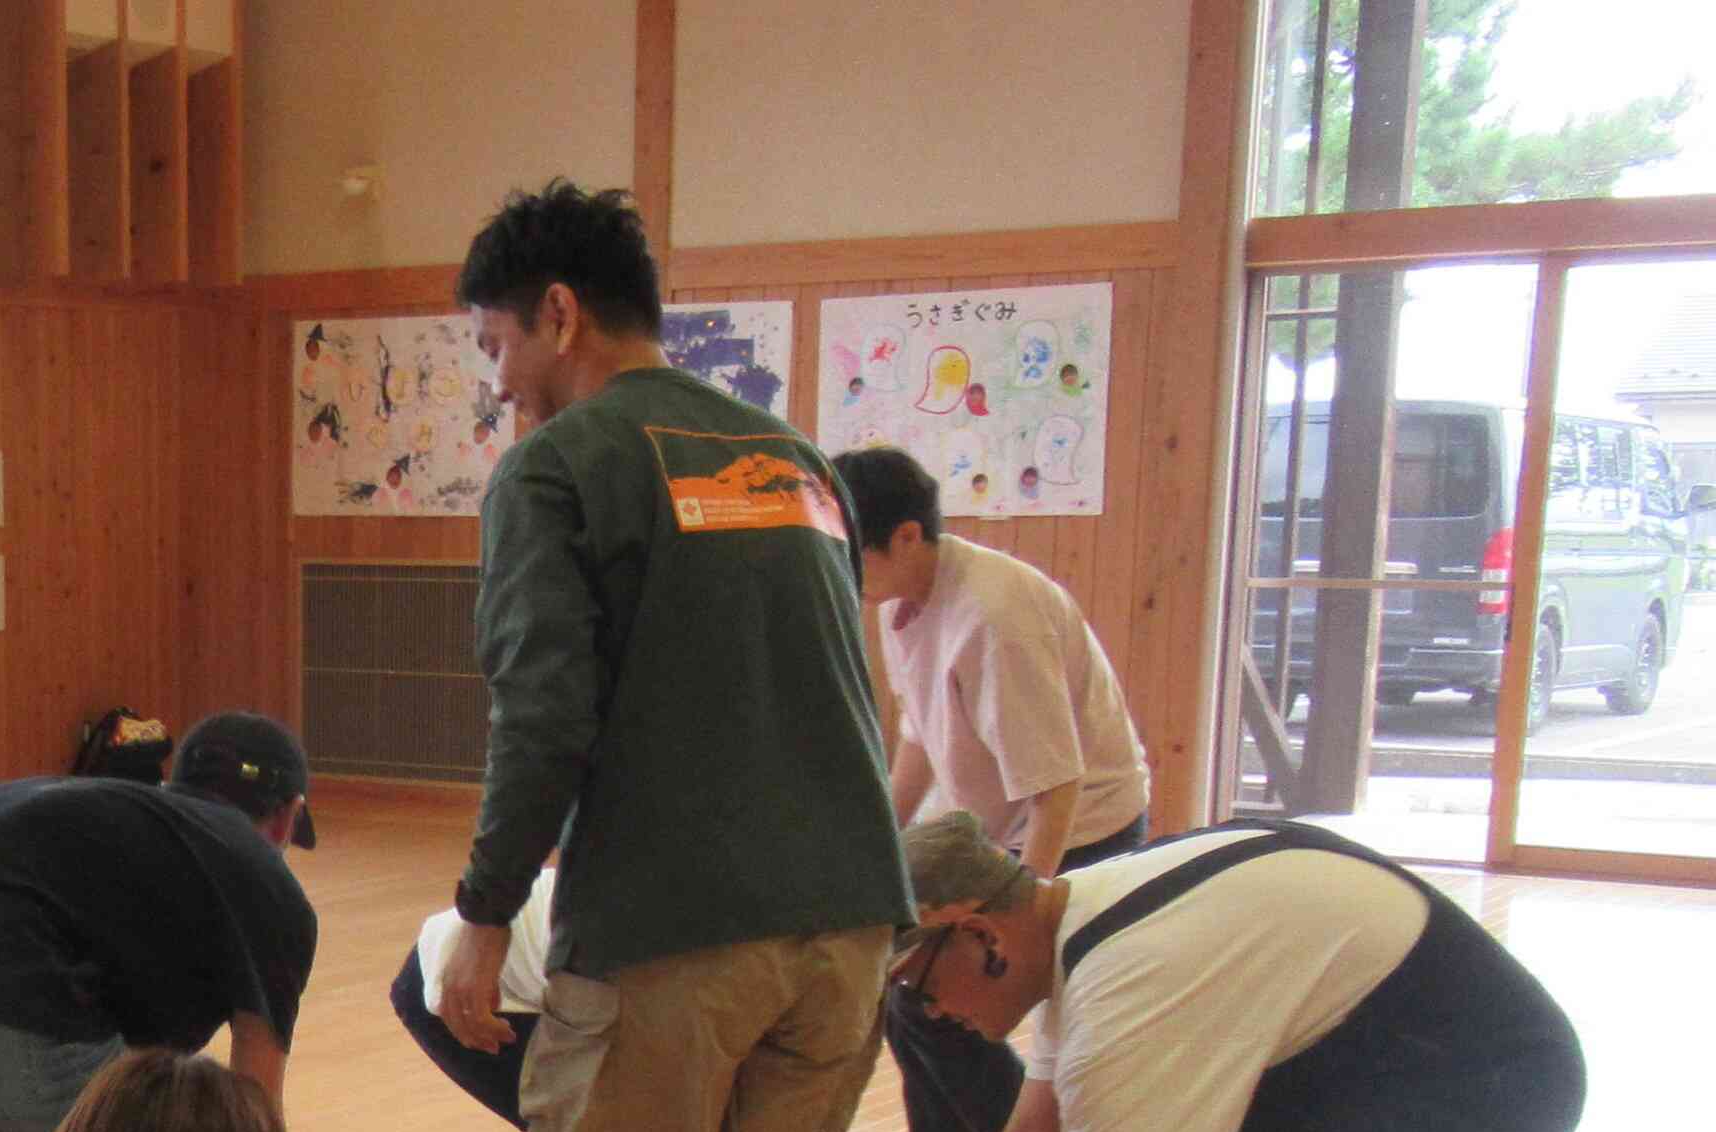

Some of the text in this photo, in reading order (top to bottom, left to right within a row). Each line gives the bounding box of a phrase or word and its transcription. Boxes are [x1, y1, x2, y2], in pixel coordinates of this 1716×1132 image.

[906, 298, 1017, 329] うさぎぐみ
